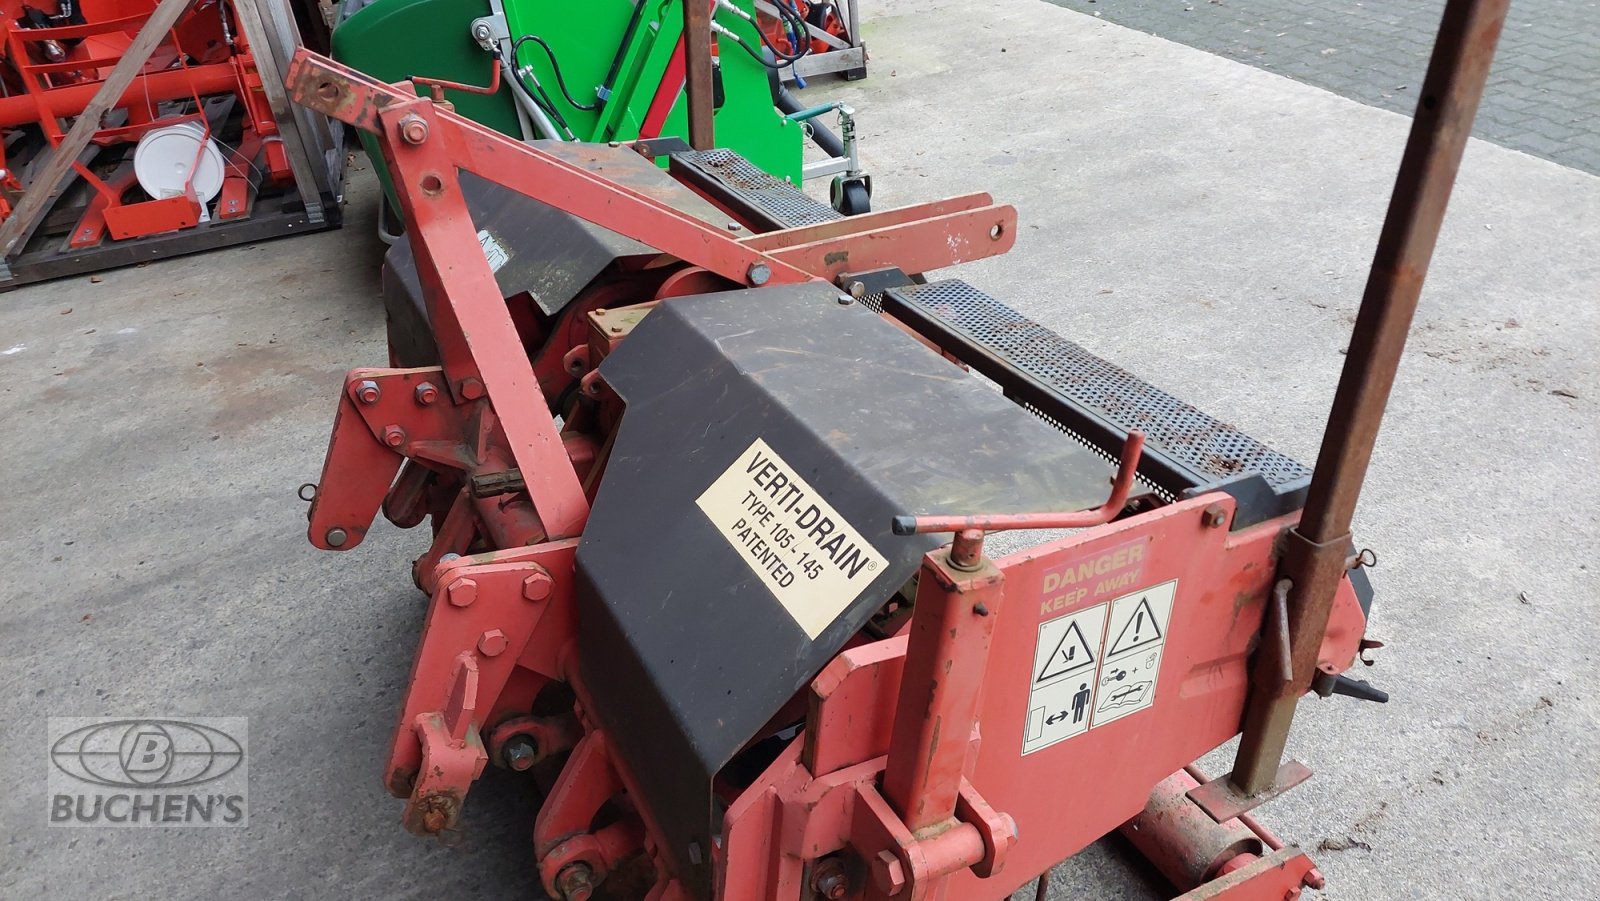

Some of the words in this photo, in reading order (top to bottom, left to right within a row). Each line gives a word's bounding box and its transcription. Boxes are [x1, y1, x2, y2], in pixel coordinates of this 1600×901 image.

[731, 518, 795, 588] PATENTED
[741, 490, 775, 528] TYPE
[769, 522, 795, 549] 105
[796, 552, 824, 580] 145
[1040, 587, 1088, 616] KEEP
[1094, 569, 1140, 596] AWAY
[1043, 545, 1144, 593] DANGER
